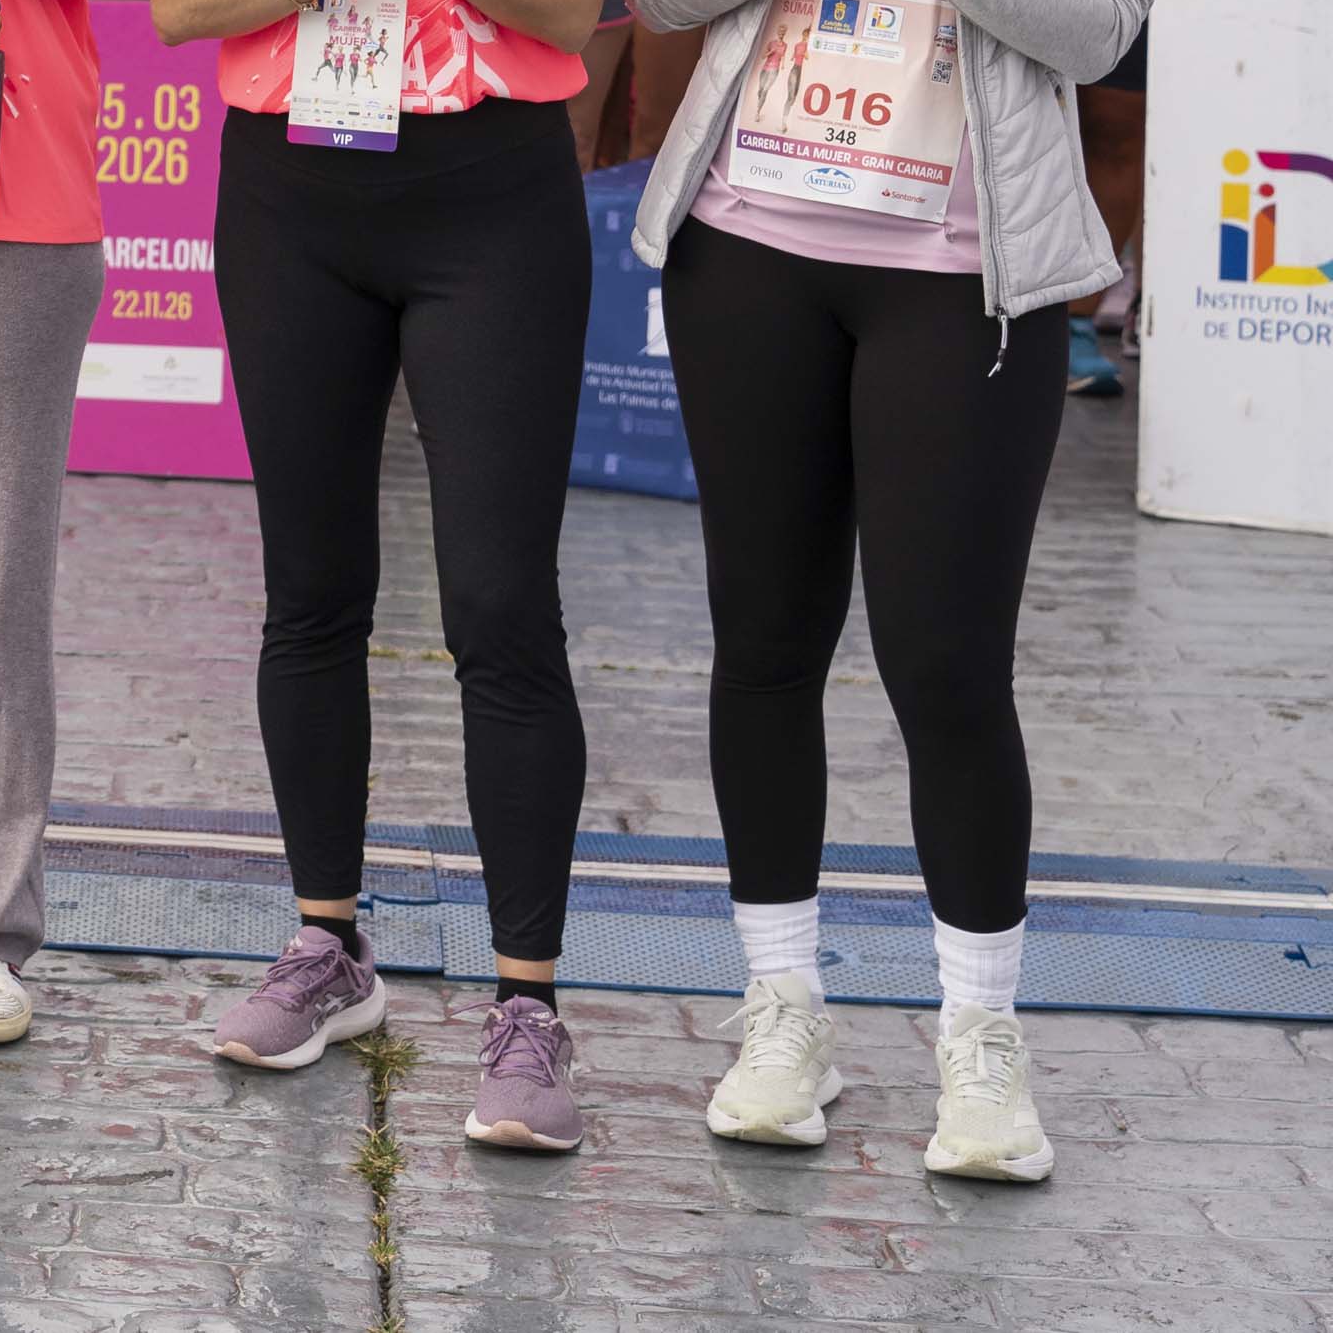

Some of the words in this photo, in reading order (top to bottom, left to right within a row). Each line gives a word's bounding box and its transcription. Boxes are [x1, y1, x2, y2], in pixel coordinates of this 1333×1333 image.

[783, 1, 815, 16] SUMA
[333, 25, 367, 33] CARRERA
[329, 35, 367, 46] MUJER
[803, 82, 893, 127] 016
[332, 132, 354, 145] VIP
[825, 128, 857, 146] 348
[96, 136, 188, 185] 2026
[741, 134, 781, 152] CARRERA
[783, 142, 795, 155] DE
[797, 144, 810, 157] LA
[813, 146, 851, 164] MUJER
[862, 155, 894, 172] GRAN
[897, 162, 944, 182] CANARIA
[750, 166, 783, 180] OYSHO
[808, 174, 852, 191] ASTURIANA
[892, 191, 927, 204] Santander
[111, 289, 193, 321] 22.11.26
[1196, 286, 1298, 314] INSTITUTO
[1204, 321, 1229, 340] DE
[1238, 317, 1333, 346] DEPOR
